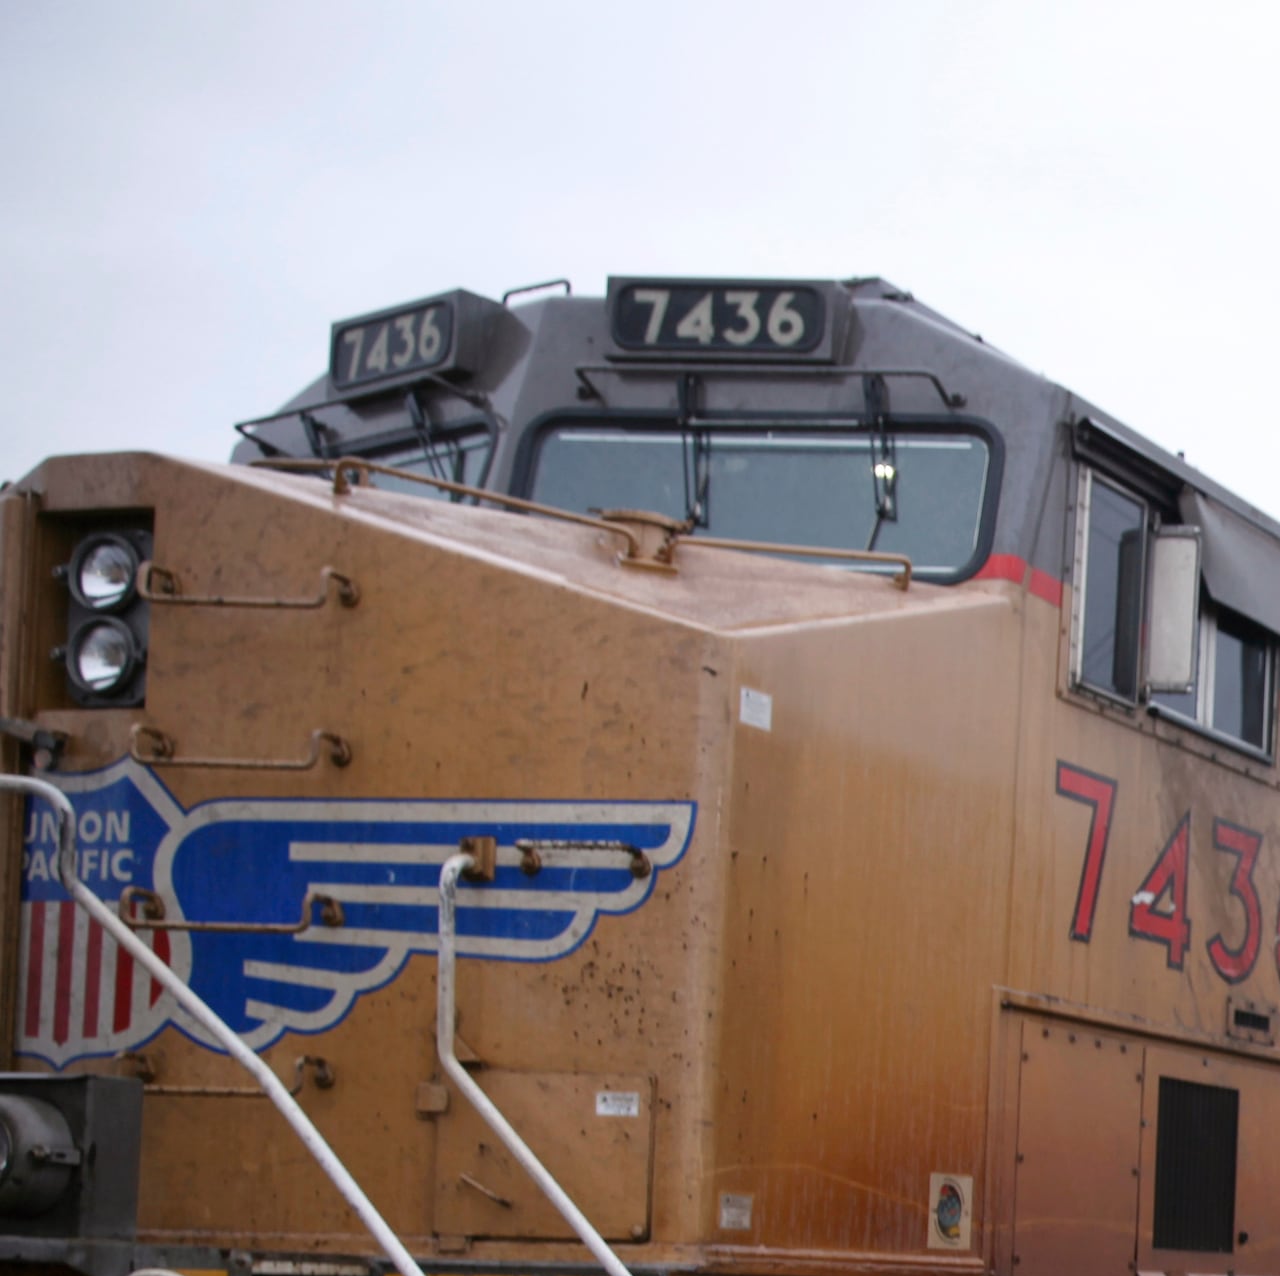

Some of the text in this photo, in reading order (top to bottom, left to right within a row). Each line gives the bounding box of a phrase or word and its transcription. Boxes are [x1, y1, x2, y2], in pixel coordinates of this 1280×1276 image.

[343, 308, 441, 382] 7436
[634, 289, 804, 346] 7436
[25, 810, 130, 843] UNON
